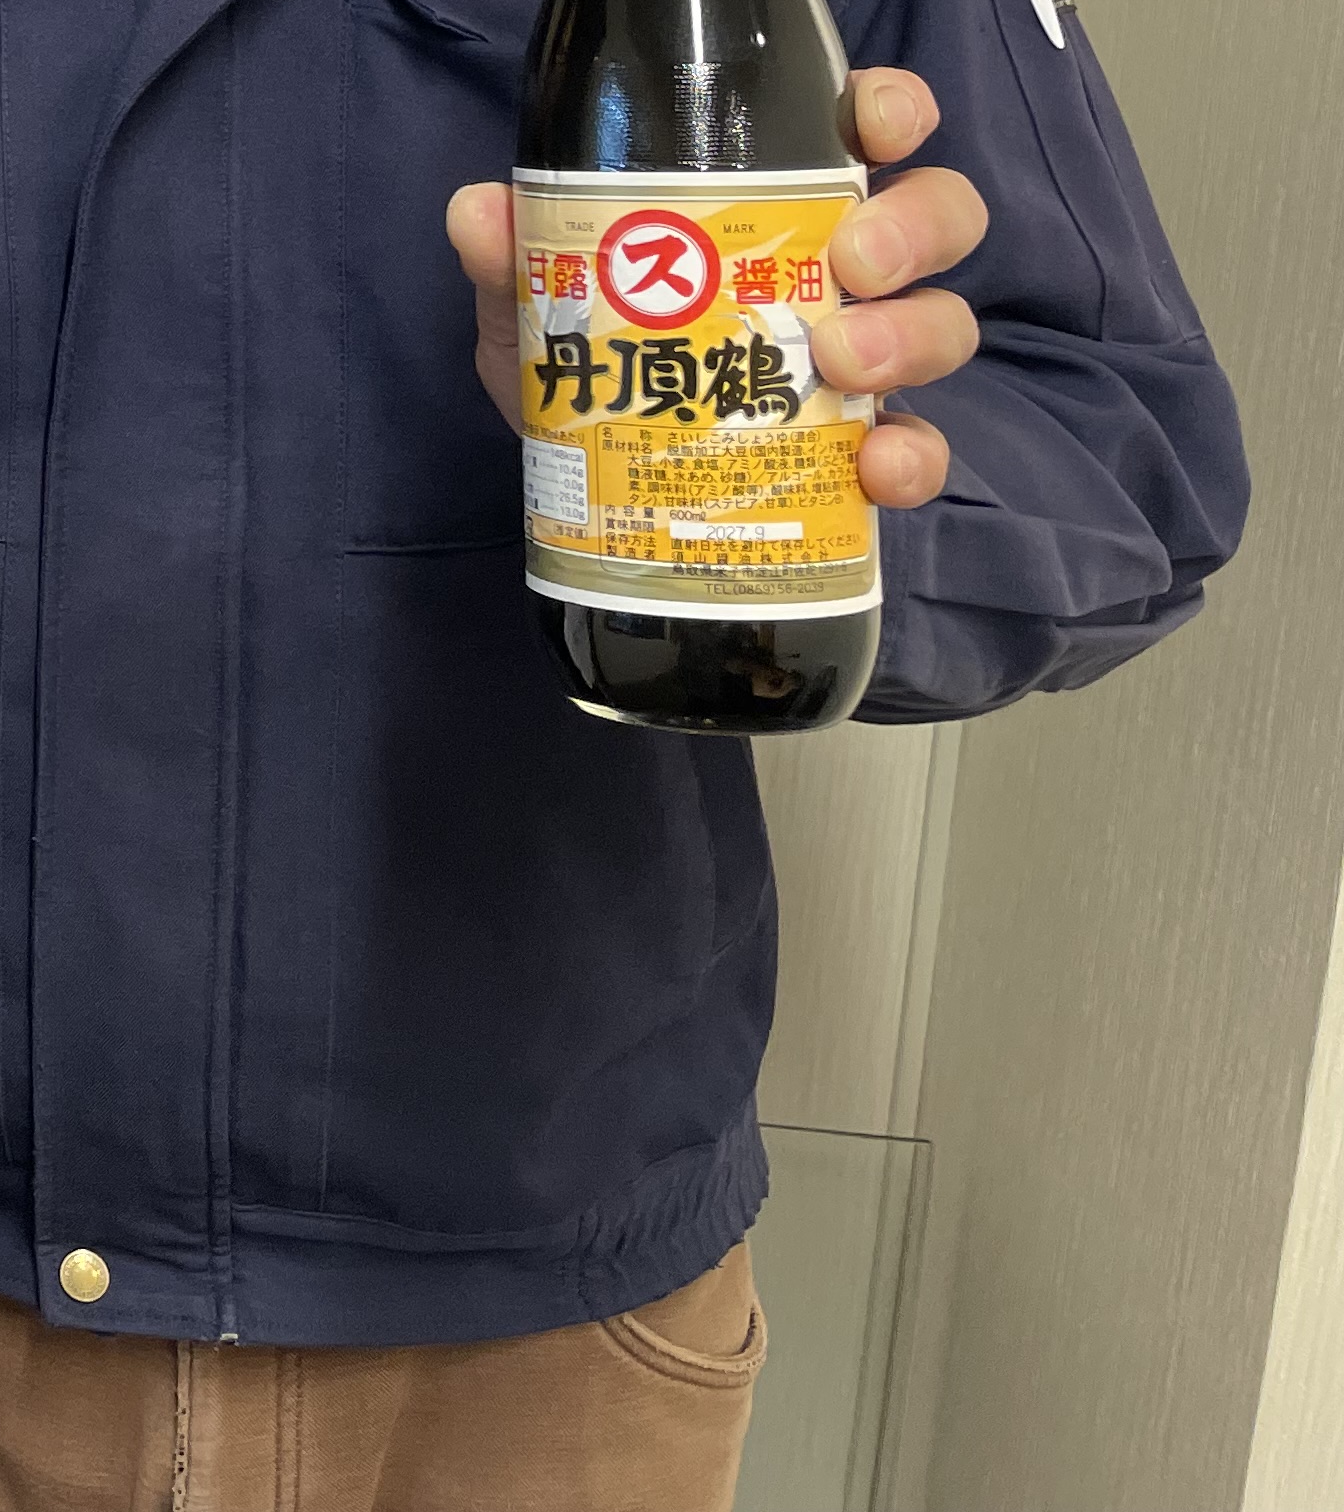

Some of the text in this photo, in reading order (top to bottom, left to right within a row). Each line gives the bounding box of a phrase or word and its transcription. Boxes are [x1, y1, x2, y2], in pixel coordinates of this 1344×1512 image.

[565, 221, 757, 235] TRADE MARK
[526, 234, 824, 306] 甘露 ス 醤油
[534, 331, 800, 426] 丹頂鶴
[601, 439, 653, 455] 原材料名
[605, 504, 655, 519] 内容量
[605, 517, 765, 541] 賞味期限 2027.9
[606, 531, 656, 548] 保存方法
